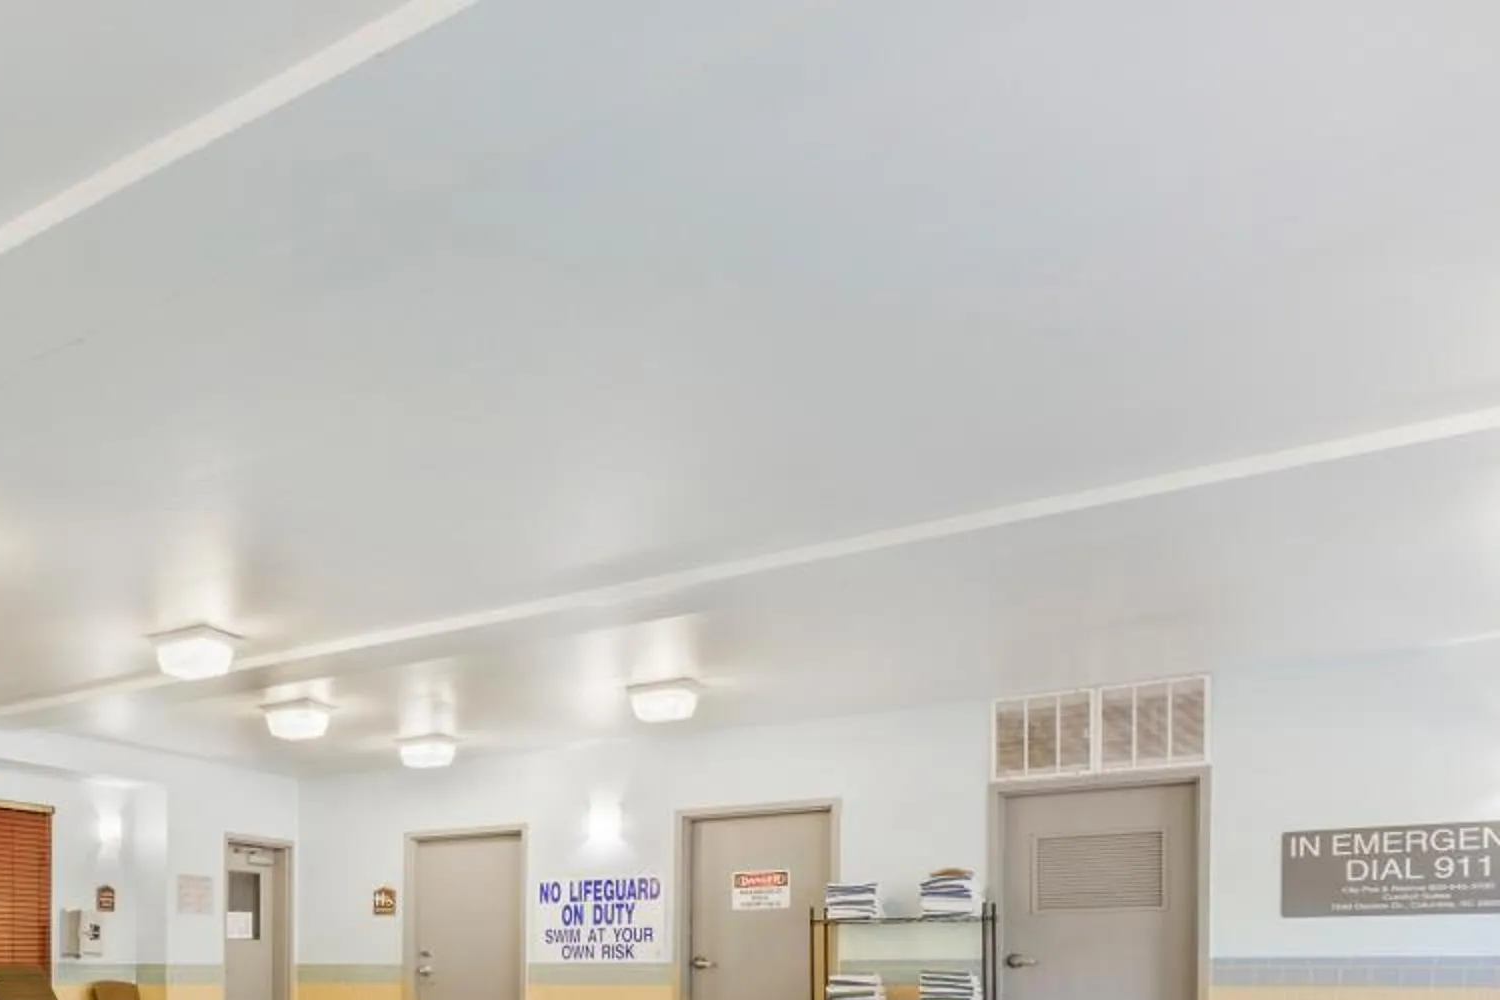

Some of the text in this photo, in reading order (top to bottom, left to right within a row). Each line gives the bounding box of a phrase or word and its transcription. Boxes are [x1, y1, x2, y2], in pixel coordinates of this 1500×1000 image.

[1290, 835, 1320, 858] IN
[1346, 855, 1492, 882] DIAL 911
[539, 877, 661, 904] NO LIFEGUARD
[561, 902, 635, 926] ON DUTY
[544, 926, 654, 944] SWIM AT YOUR
[561, 943, 635, 960] OWN RISK
